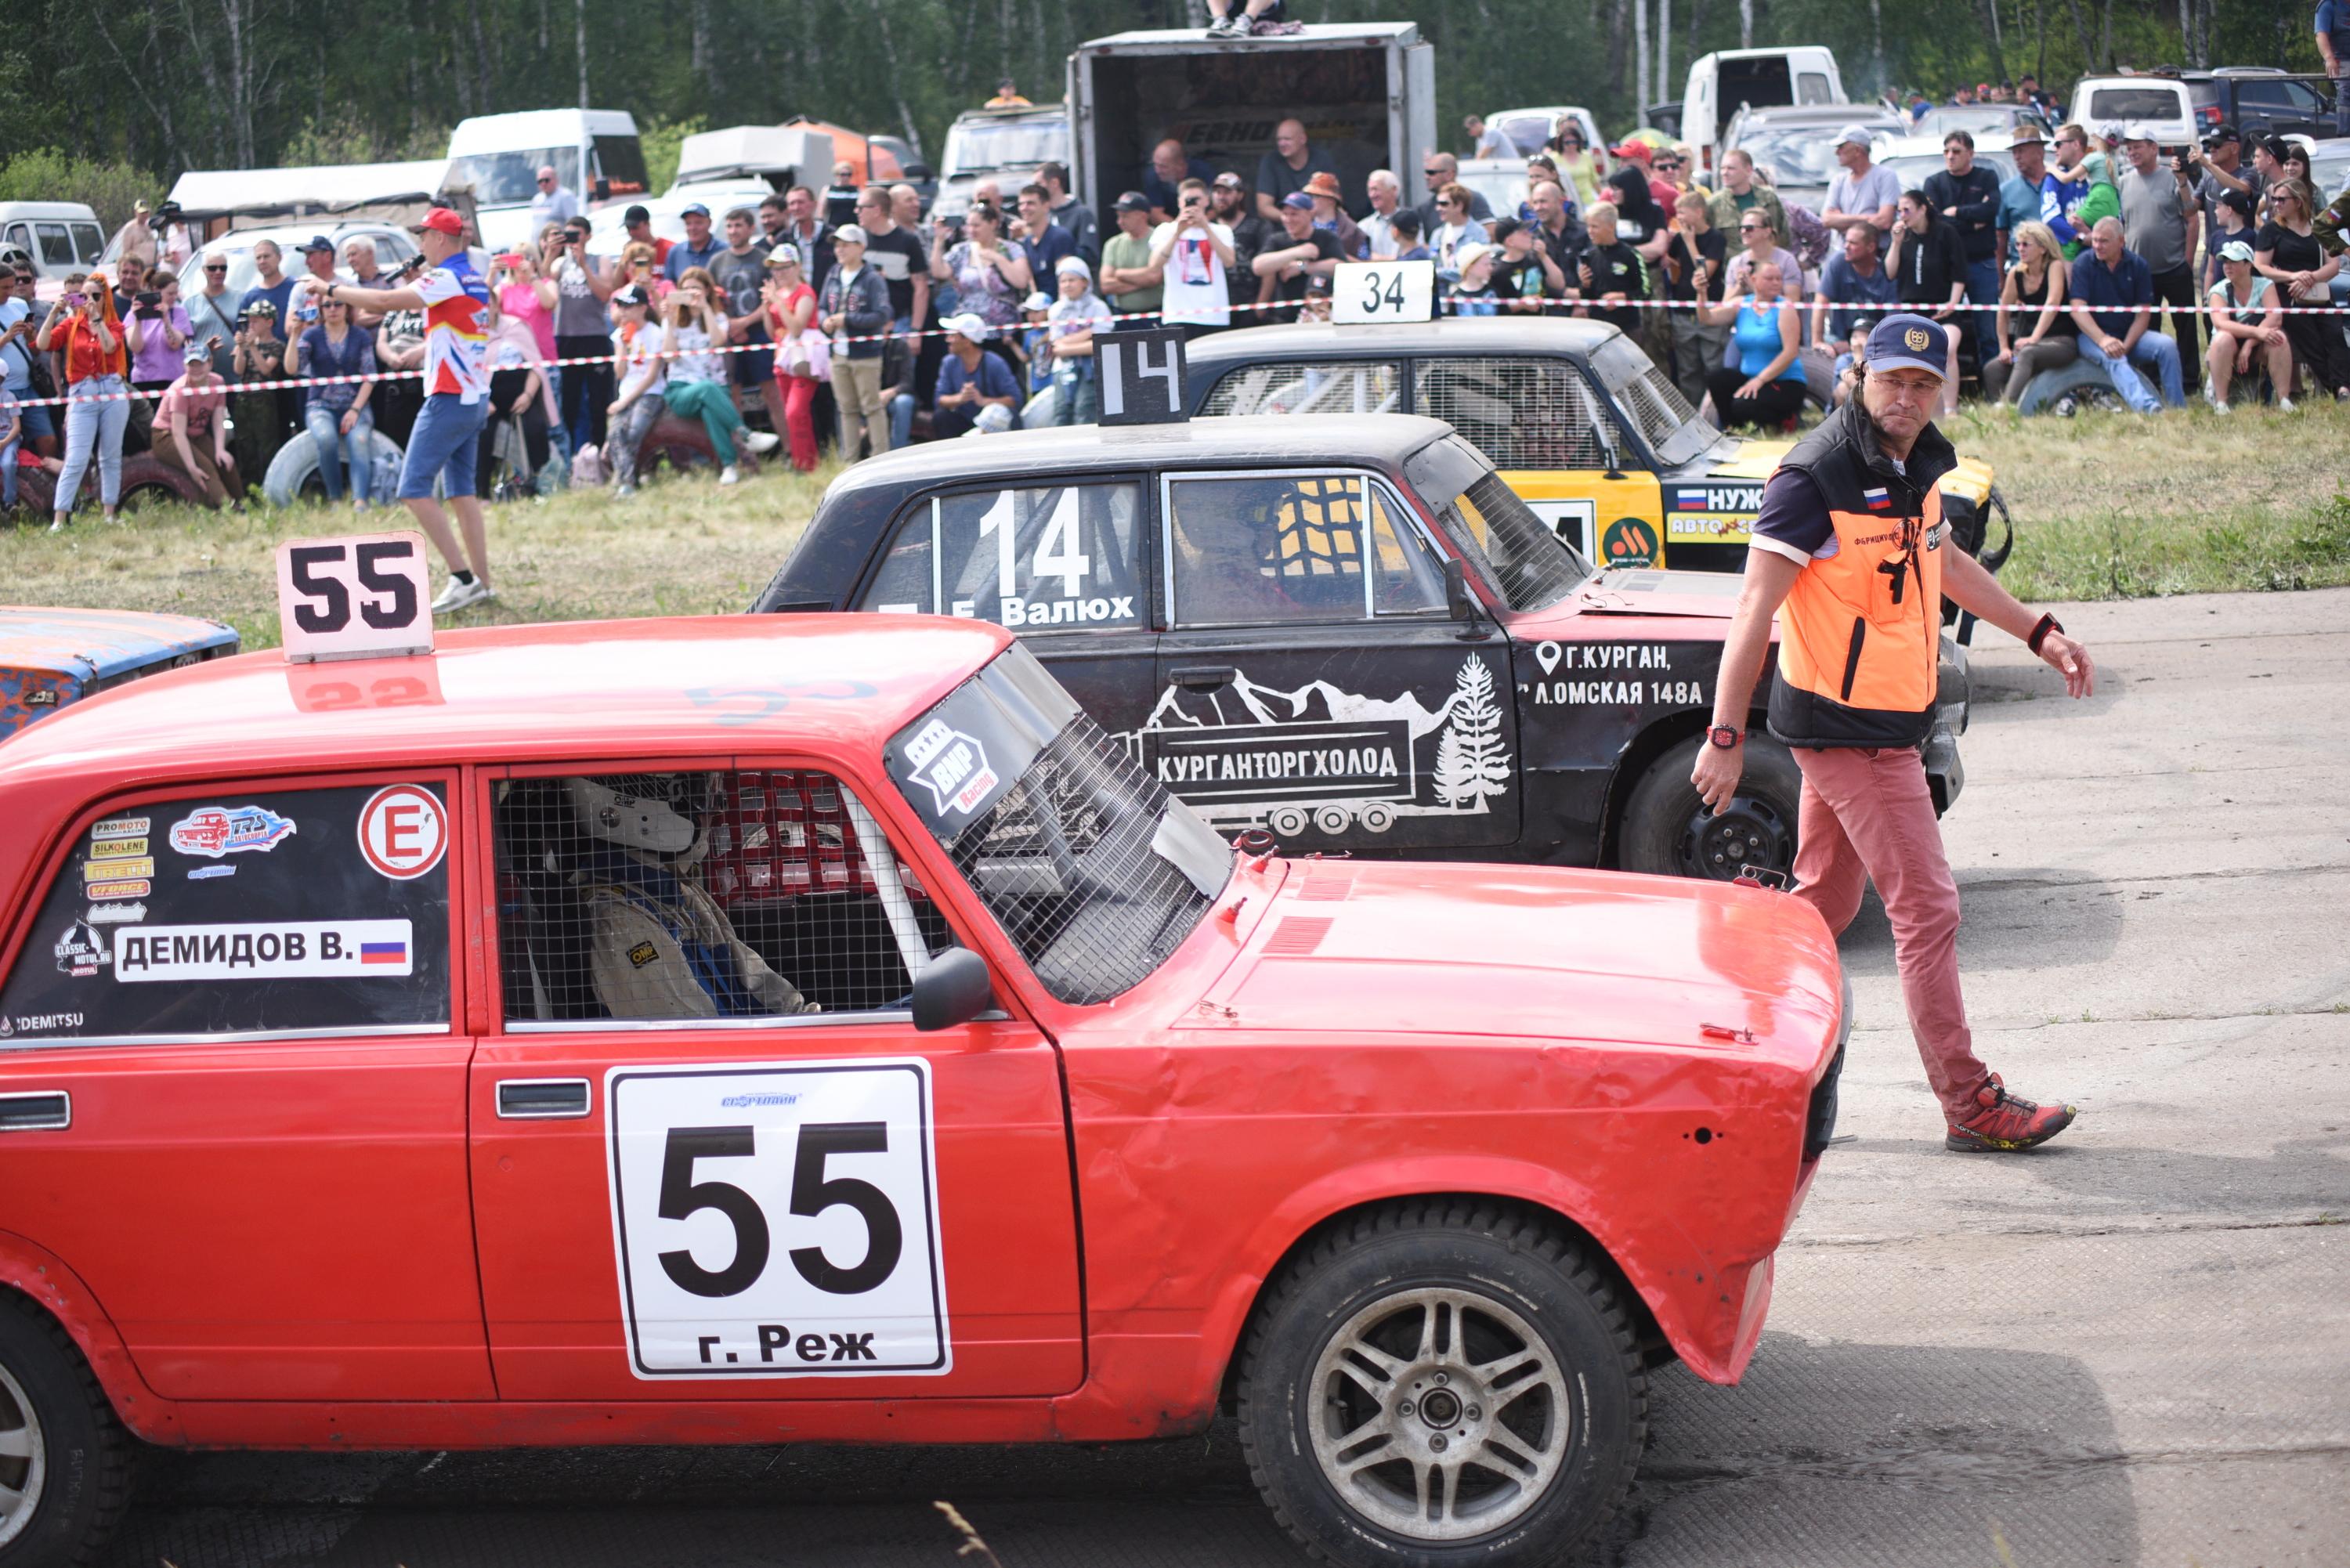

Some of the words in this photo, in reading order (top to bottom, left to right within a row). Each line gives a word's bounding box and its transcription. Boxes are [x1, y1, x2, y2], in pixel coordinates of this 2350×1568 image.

[1361, 271, 1405, 313] 34
[1101, 340, 1180, 415] 14
[980, 487, 1090, 598] 14
[290, 541, 418, 634] 55
[1000, 596, 1135, 627] Валюх
[1567, 646, 1671, 671] Г.КУРГАН,
[1650, 681, 1703, 704] 148А
[1158, 747, 1398, 782] КУРГАНТОРГХОЛОД
[959, 773, 995, 808] Racing
[96, 820, 147, 832] PROMOTO
[95, 840, 144, 853] SILKOLENE
[56, 942, 89, 956] CLASSIC-
[74, 952, 110, 965] MOTUL.RU
[123, 932, 307, 971] ДЕМИДОВ
[320, 931, 352, 961] В.
[632, 945, 653, 962] OMP
[73, 966, 96, 975] MOTUL
[657, 1121, 903, 1298] 55
[697, 1335, 739, 1363] г.
[757, 1324, 878, 1363] Реж
